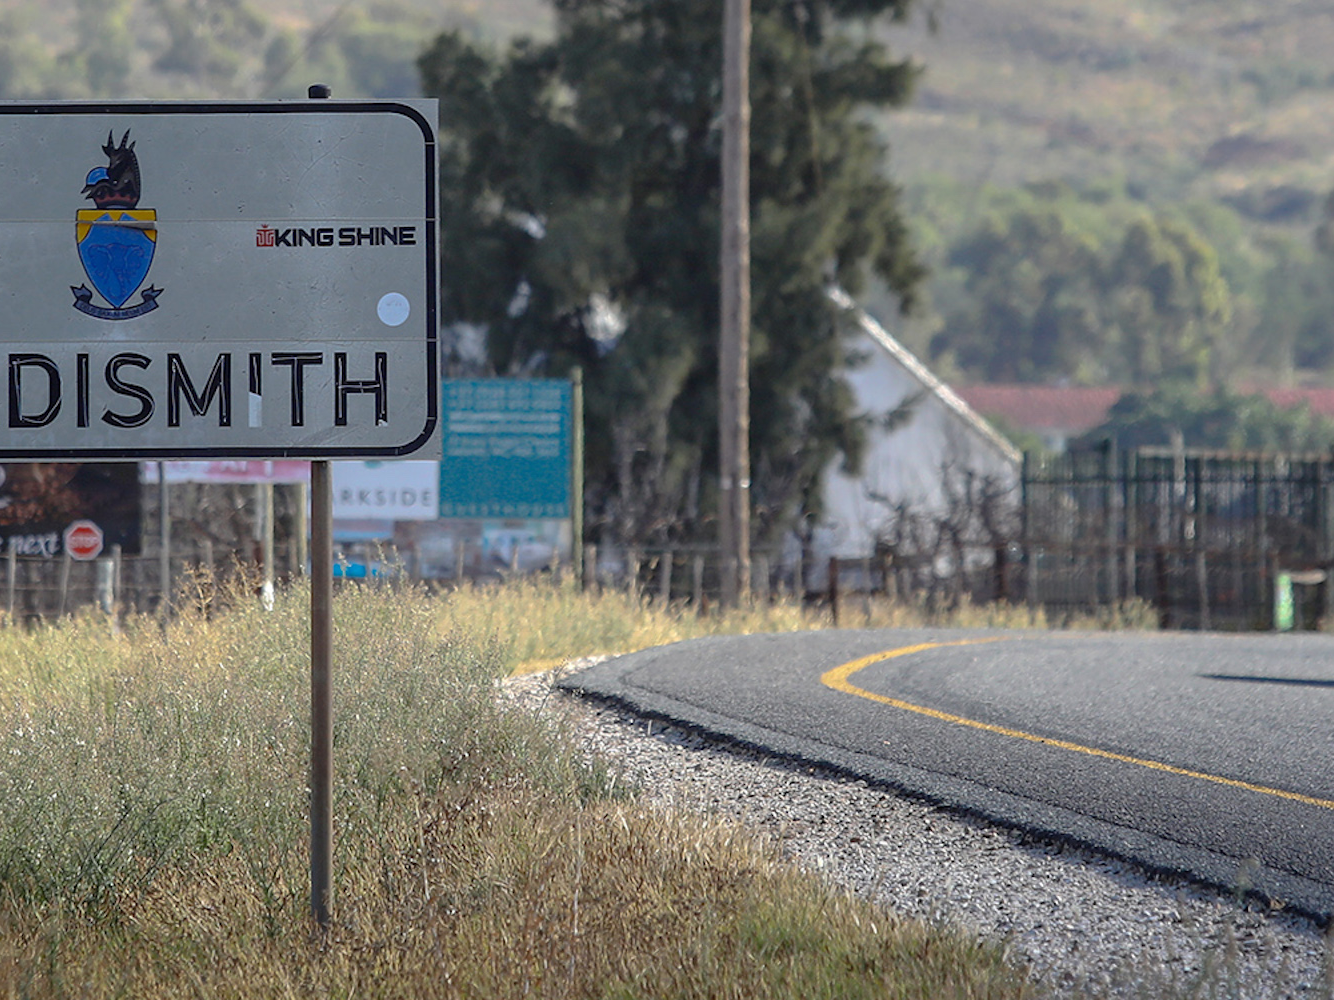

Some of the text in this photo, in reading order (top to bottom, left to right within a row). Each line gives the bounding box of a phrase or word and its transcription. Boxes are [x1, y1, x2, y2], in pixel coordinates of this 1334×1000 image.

[275, 226, 417, 247] KING SHINE
[8, 531, 59, 559] next
